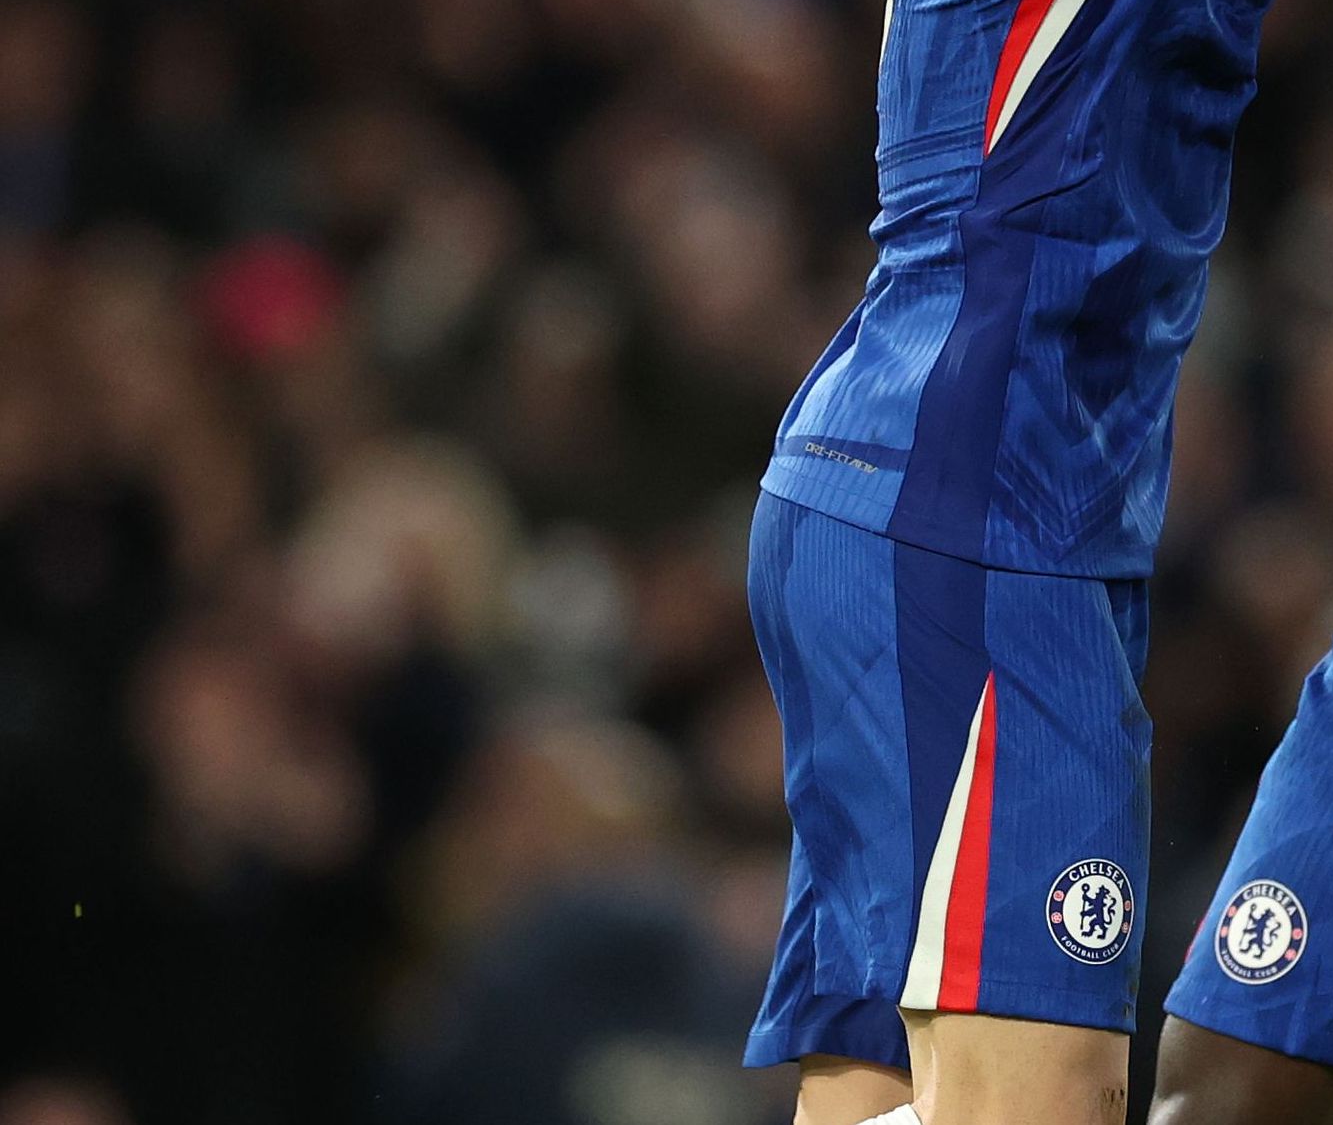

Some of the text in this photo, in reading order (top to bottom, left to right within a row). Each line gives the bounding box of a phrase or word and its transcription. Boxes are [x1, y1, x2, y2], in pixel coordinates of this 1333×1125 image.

[1068, 862, 1125, 889] CHELSEA
[1242, 885, 1297, 916] CHELSEA
[1061, 935, 1119, 959] FOOTBALL CLUB
